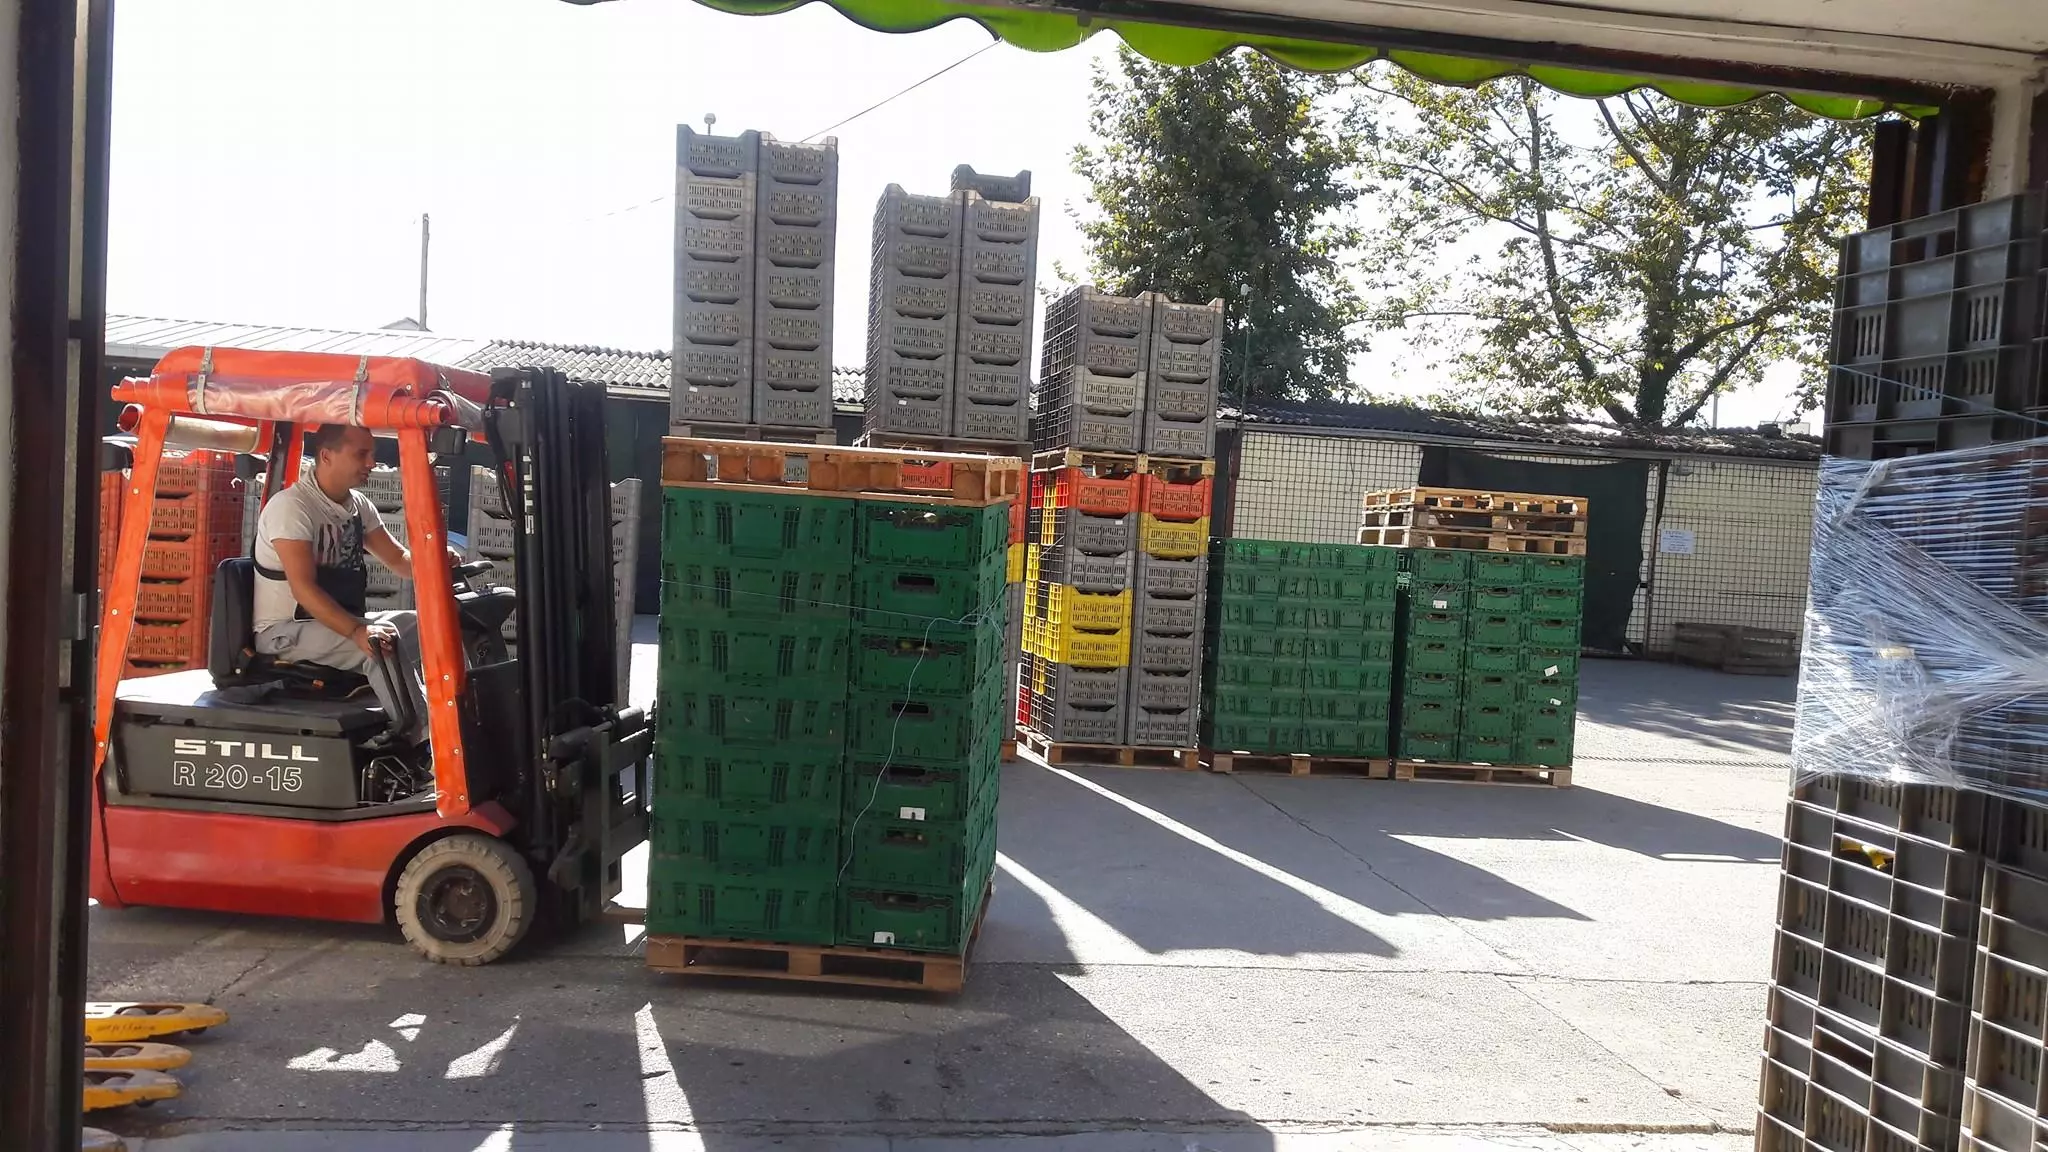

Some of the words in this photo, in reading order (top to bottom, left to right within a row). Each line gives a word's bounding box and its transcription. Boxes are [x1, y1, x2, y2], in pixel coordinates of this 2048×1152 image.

[174, 738, 319, 762] STILL
[173, 760, 196, 787] R
[204, 762, 303, 792] 20-15
